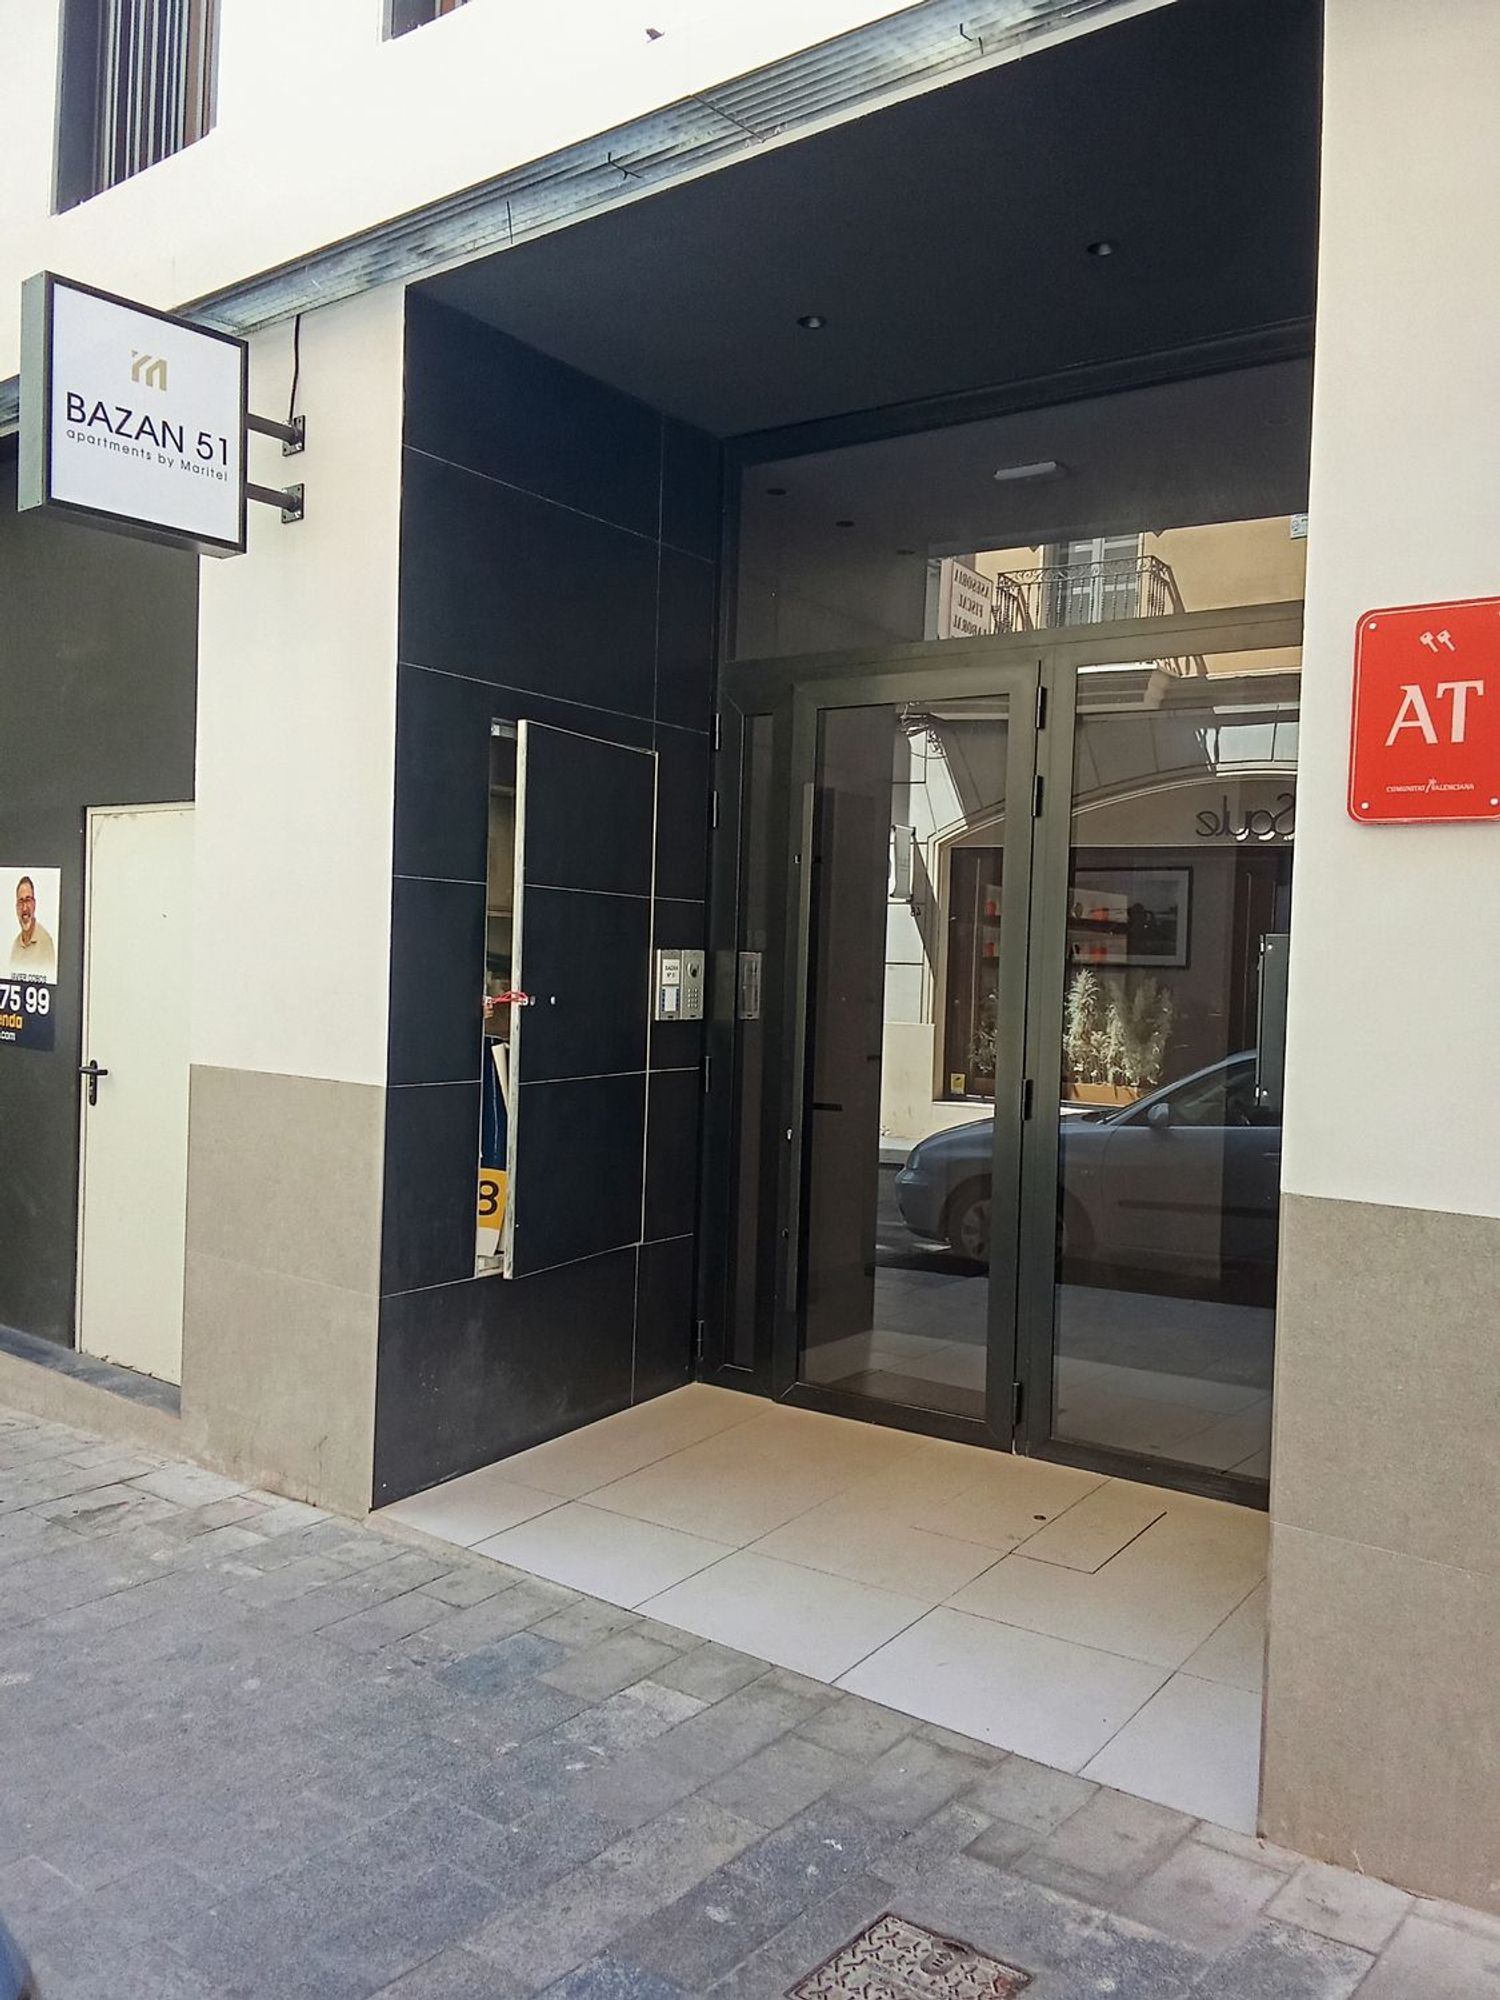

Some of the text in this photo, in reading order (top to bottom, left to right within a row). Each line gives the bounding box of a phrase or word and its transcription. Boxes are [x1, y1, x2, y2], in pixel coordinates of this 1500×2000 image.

[66, 391, 228, 466] BAZAN 51
[66, 428, 228, 481] apartments by Maritel
[1385, 680, 1484, 746] AT
[0, 984, 50, 1015] 75 99
